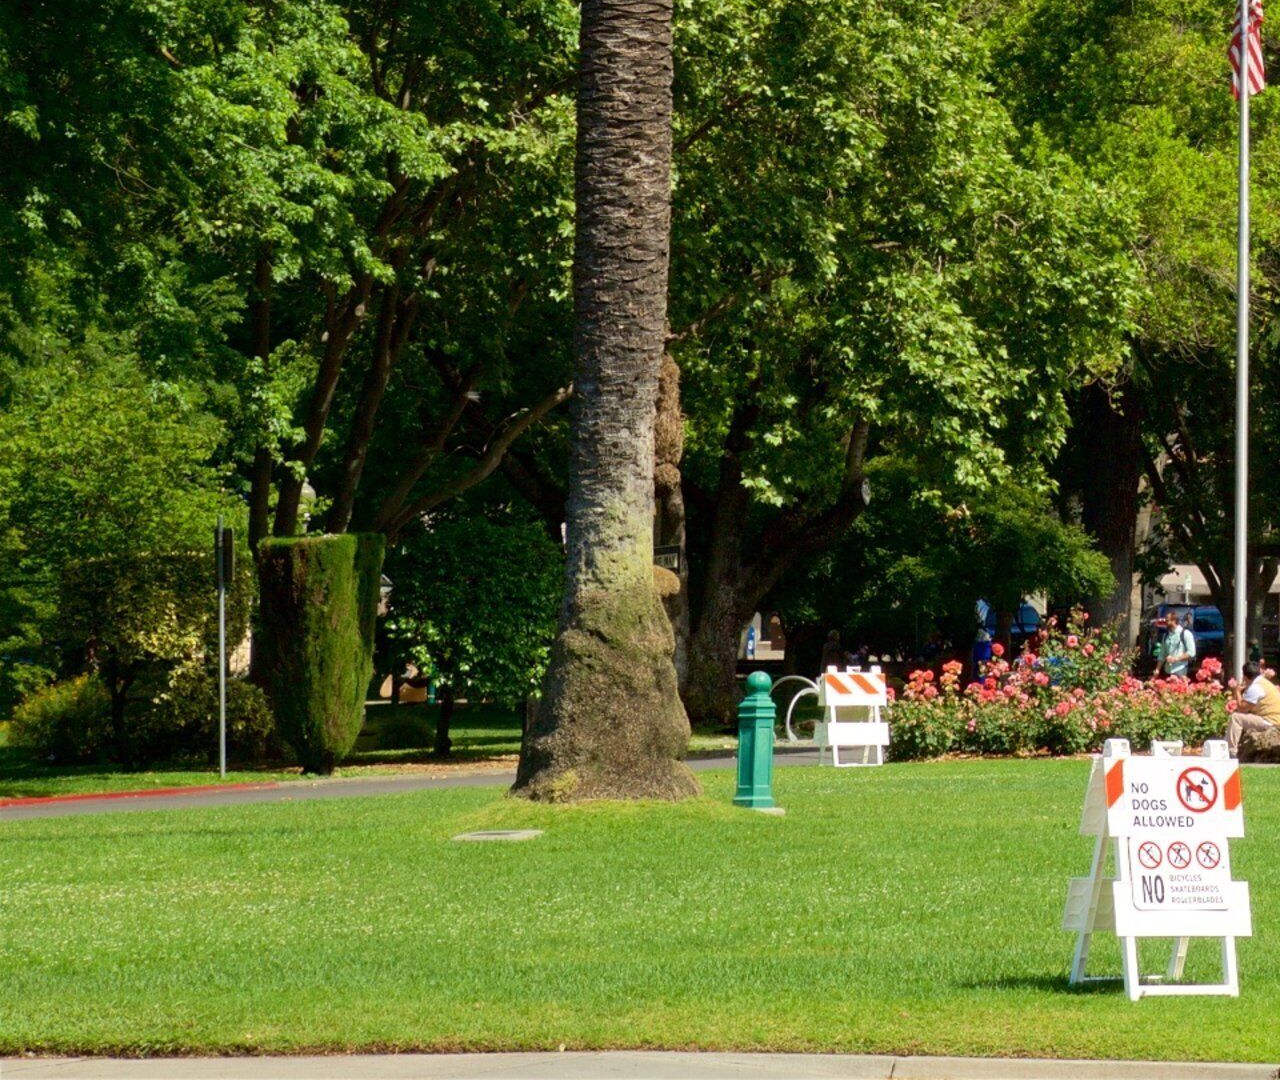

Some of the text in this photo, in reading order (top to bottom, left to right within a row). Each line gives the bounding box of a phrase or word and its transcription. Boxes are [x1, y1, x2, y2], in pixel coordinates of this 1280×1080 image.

[1131, 782, 1149, 794] NO
[1132, 799, 1168, 811] DOGS
[1133, 815, 1195, 828] ALLOWED
[1169, 874, 1202, 882] BICYCLES
[1141, 874, 1165, 904] NO
[1170, 885, 1220, 893] SKATEBOARDS
